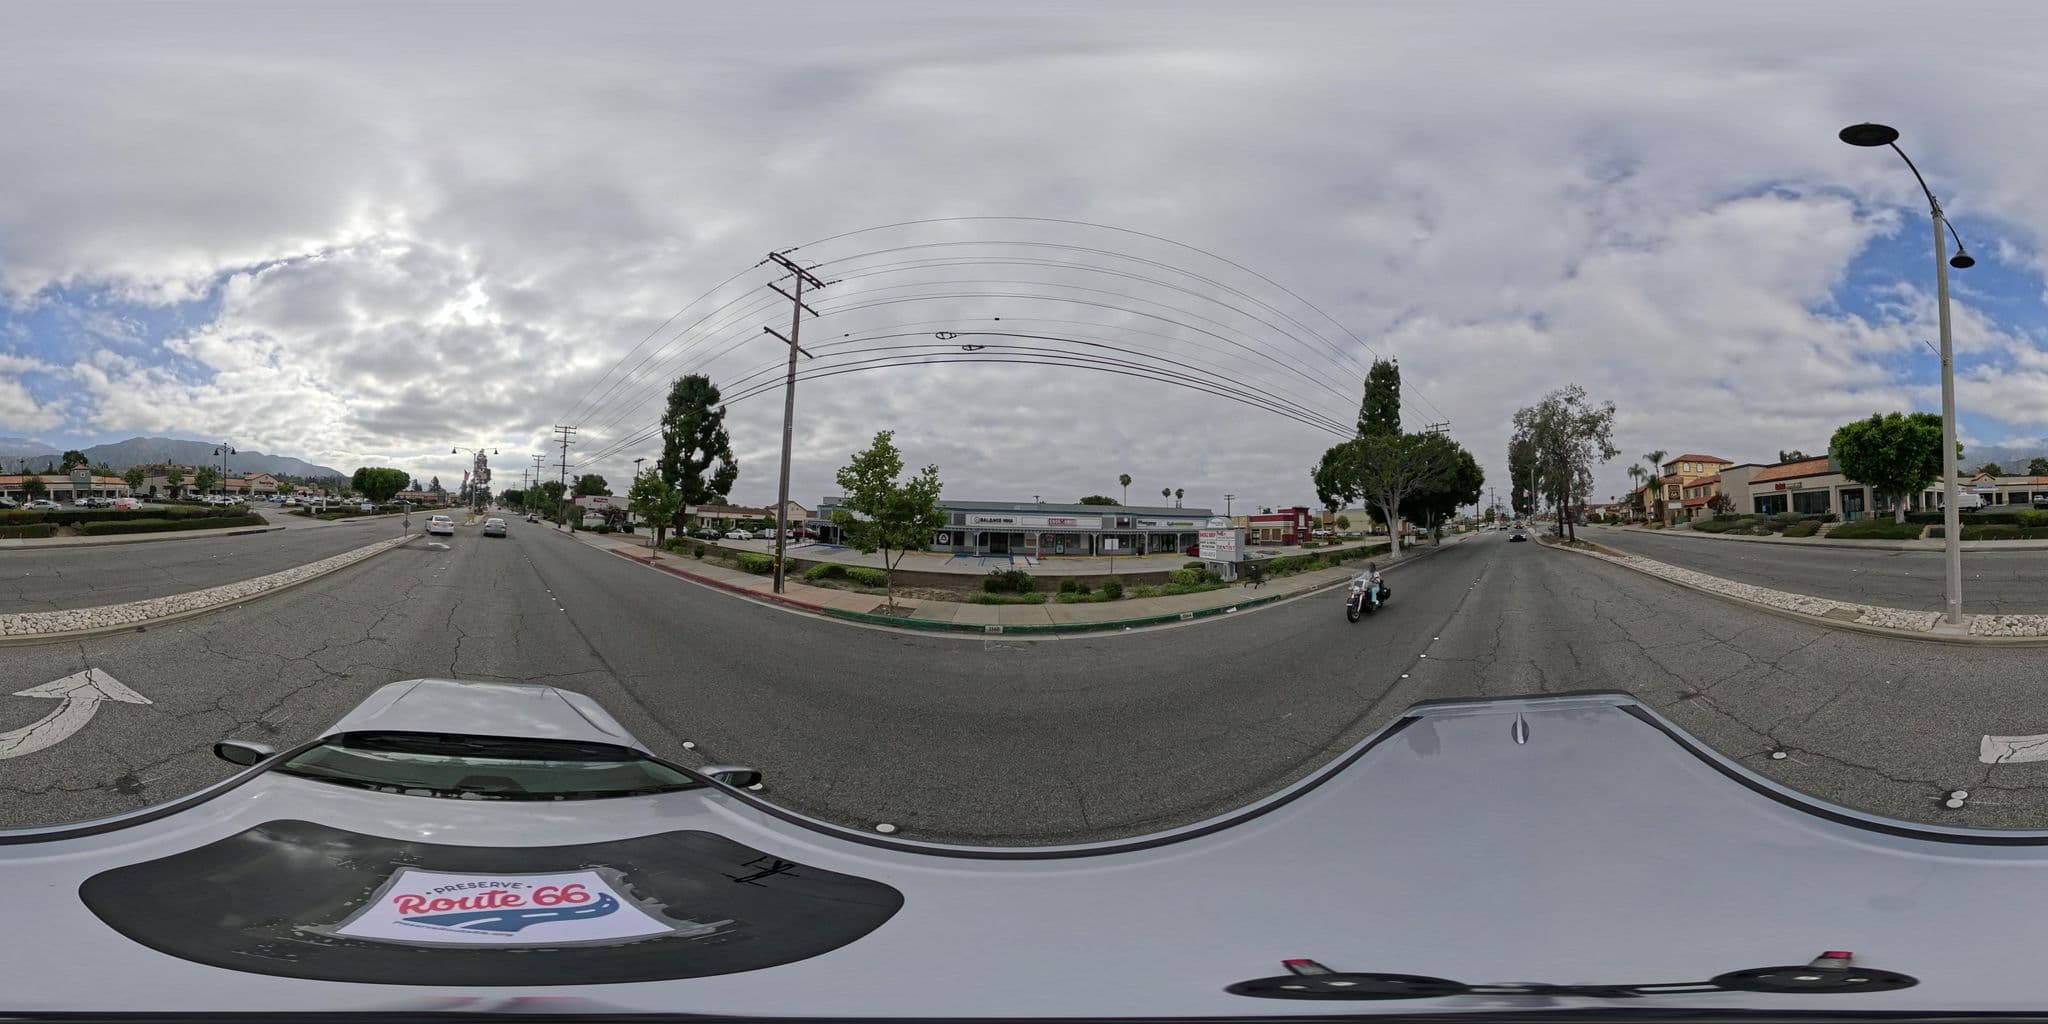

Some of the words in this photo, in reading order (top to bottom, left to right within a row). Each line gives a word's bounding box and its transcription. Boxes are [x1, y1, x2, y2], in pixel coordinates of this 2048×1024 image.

[434, 881, 523, 894] PRESERVE
[394, 890, 527, 915] Route
[532, 883, 591, 906] 66
